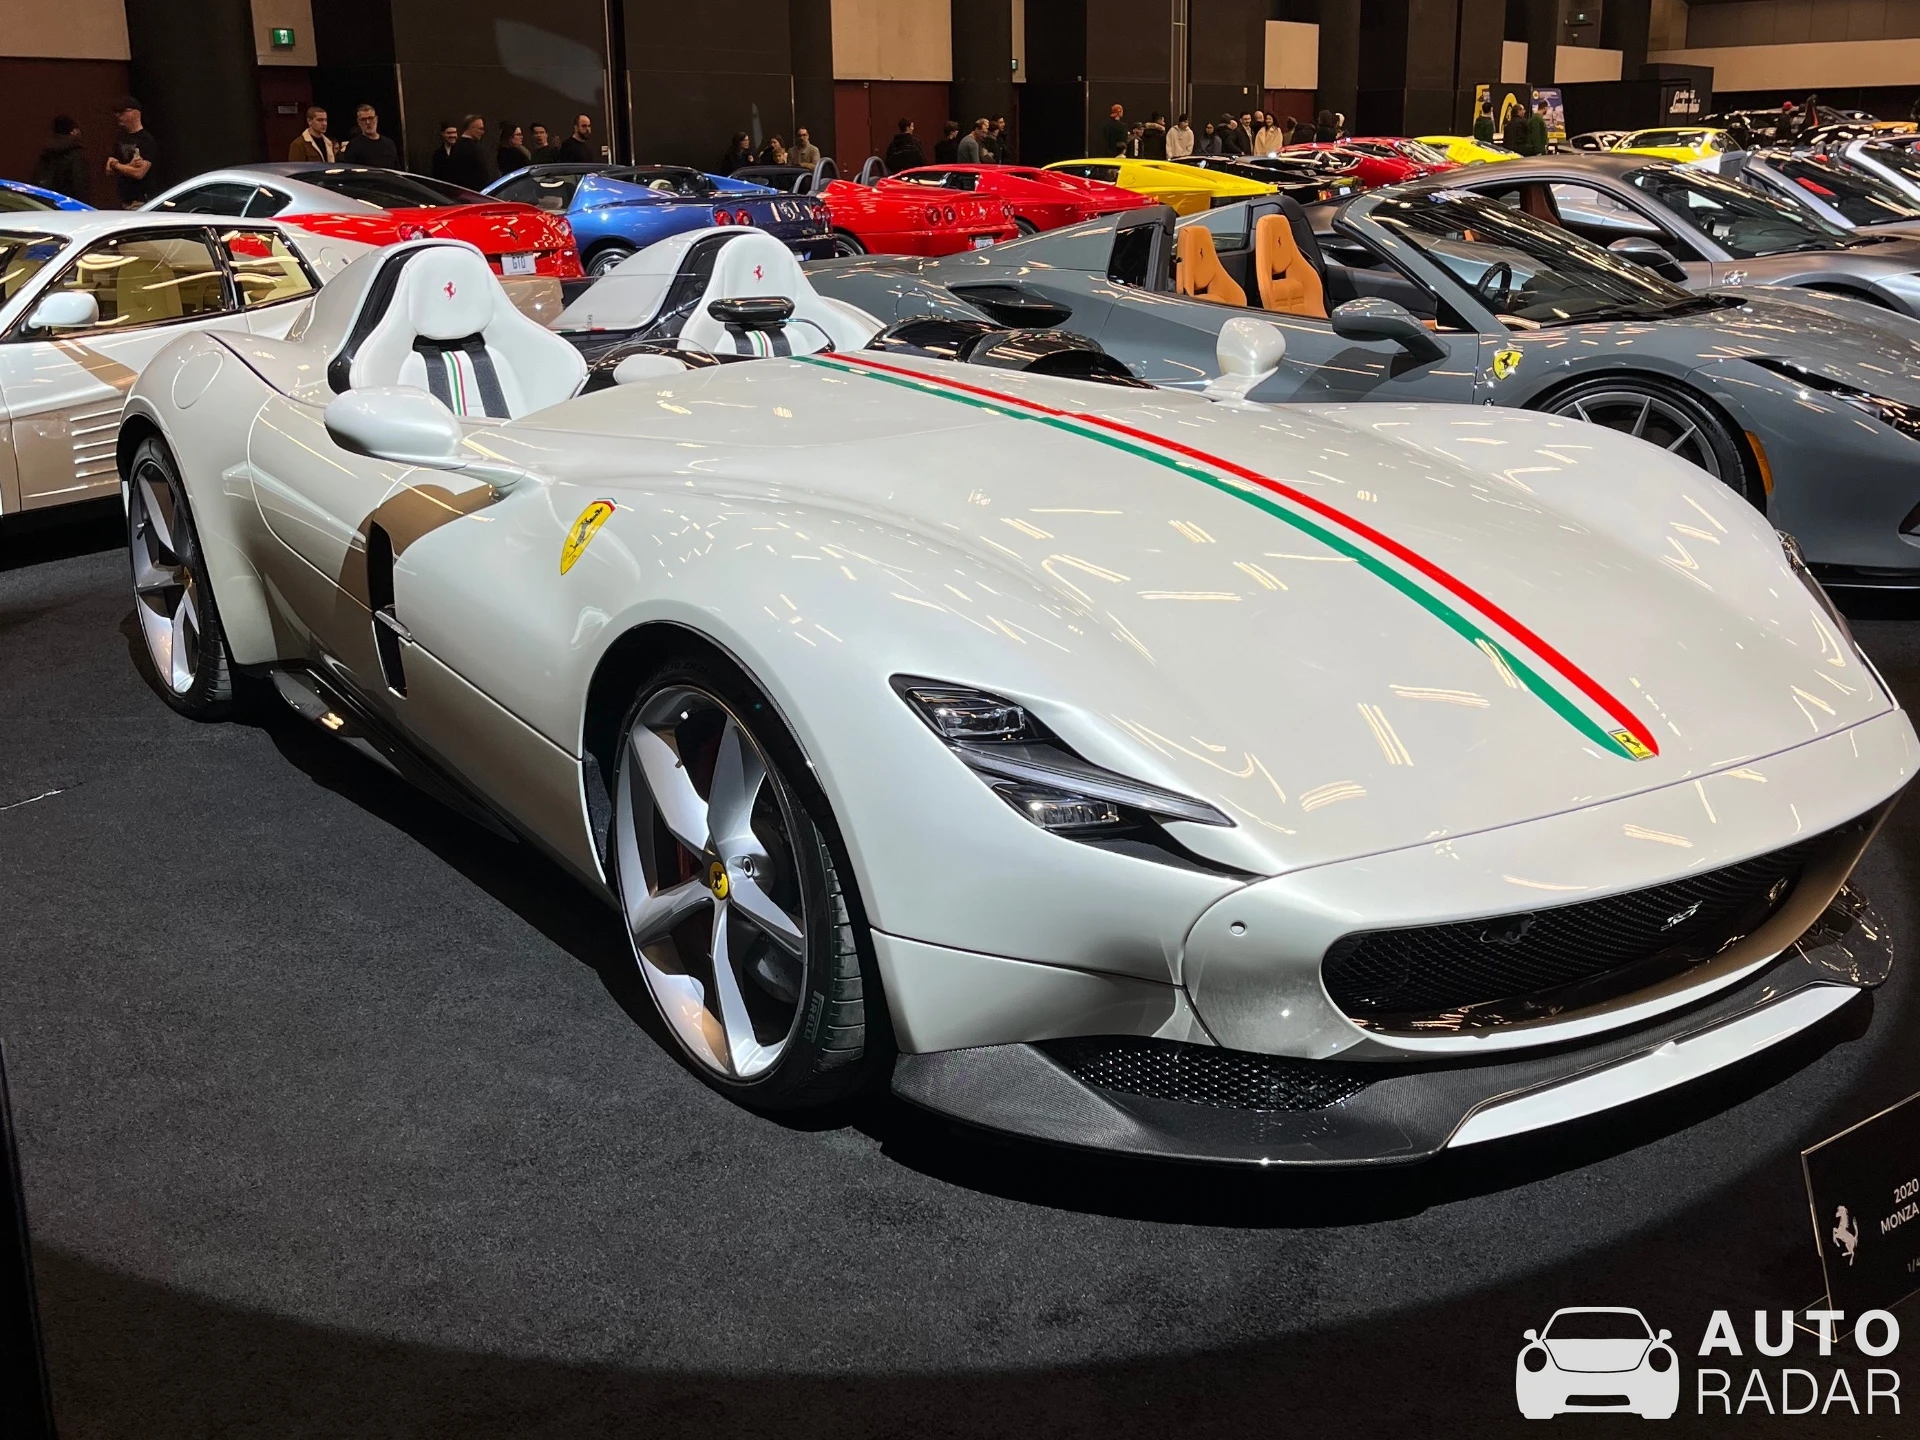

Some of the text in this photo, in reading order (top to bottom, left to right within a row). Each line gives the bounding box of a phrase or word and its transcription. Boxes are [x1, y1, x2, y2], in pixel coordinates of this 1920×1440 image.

[803, 990, 825, 1043] PIRELLI
[1893, 1178, 1920, 1204] 2020
[1880, 1202, 1920, 1235] MONZA
